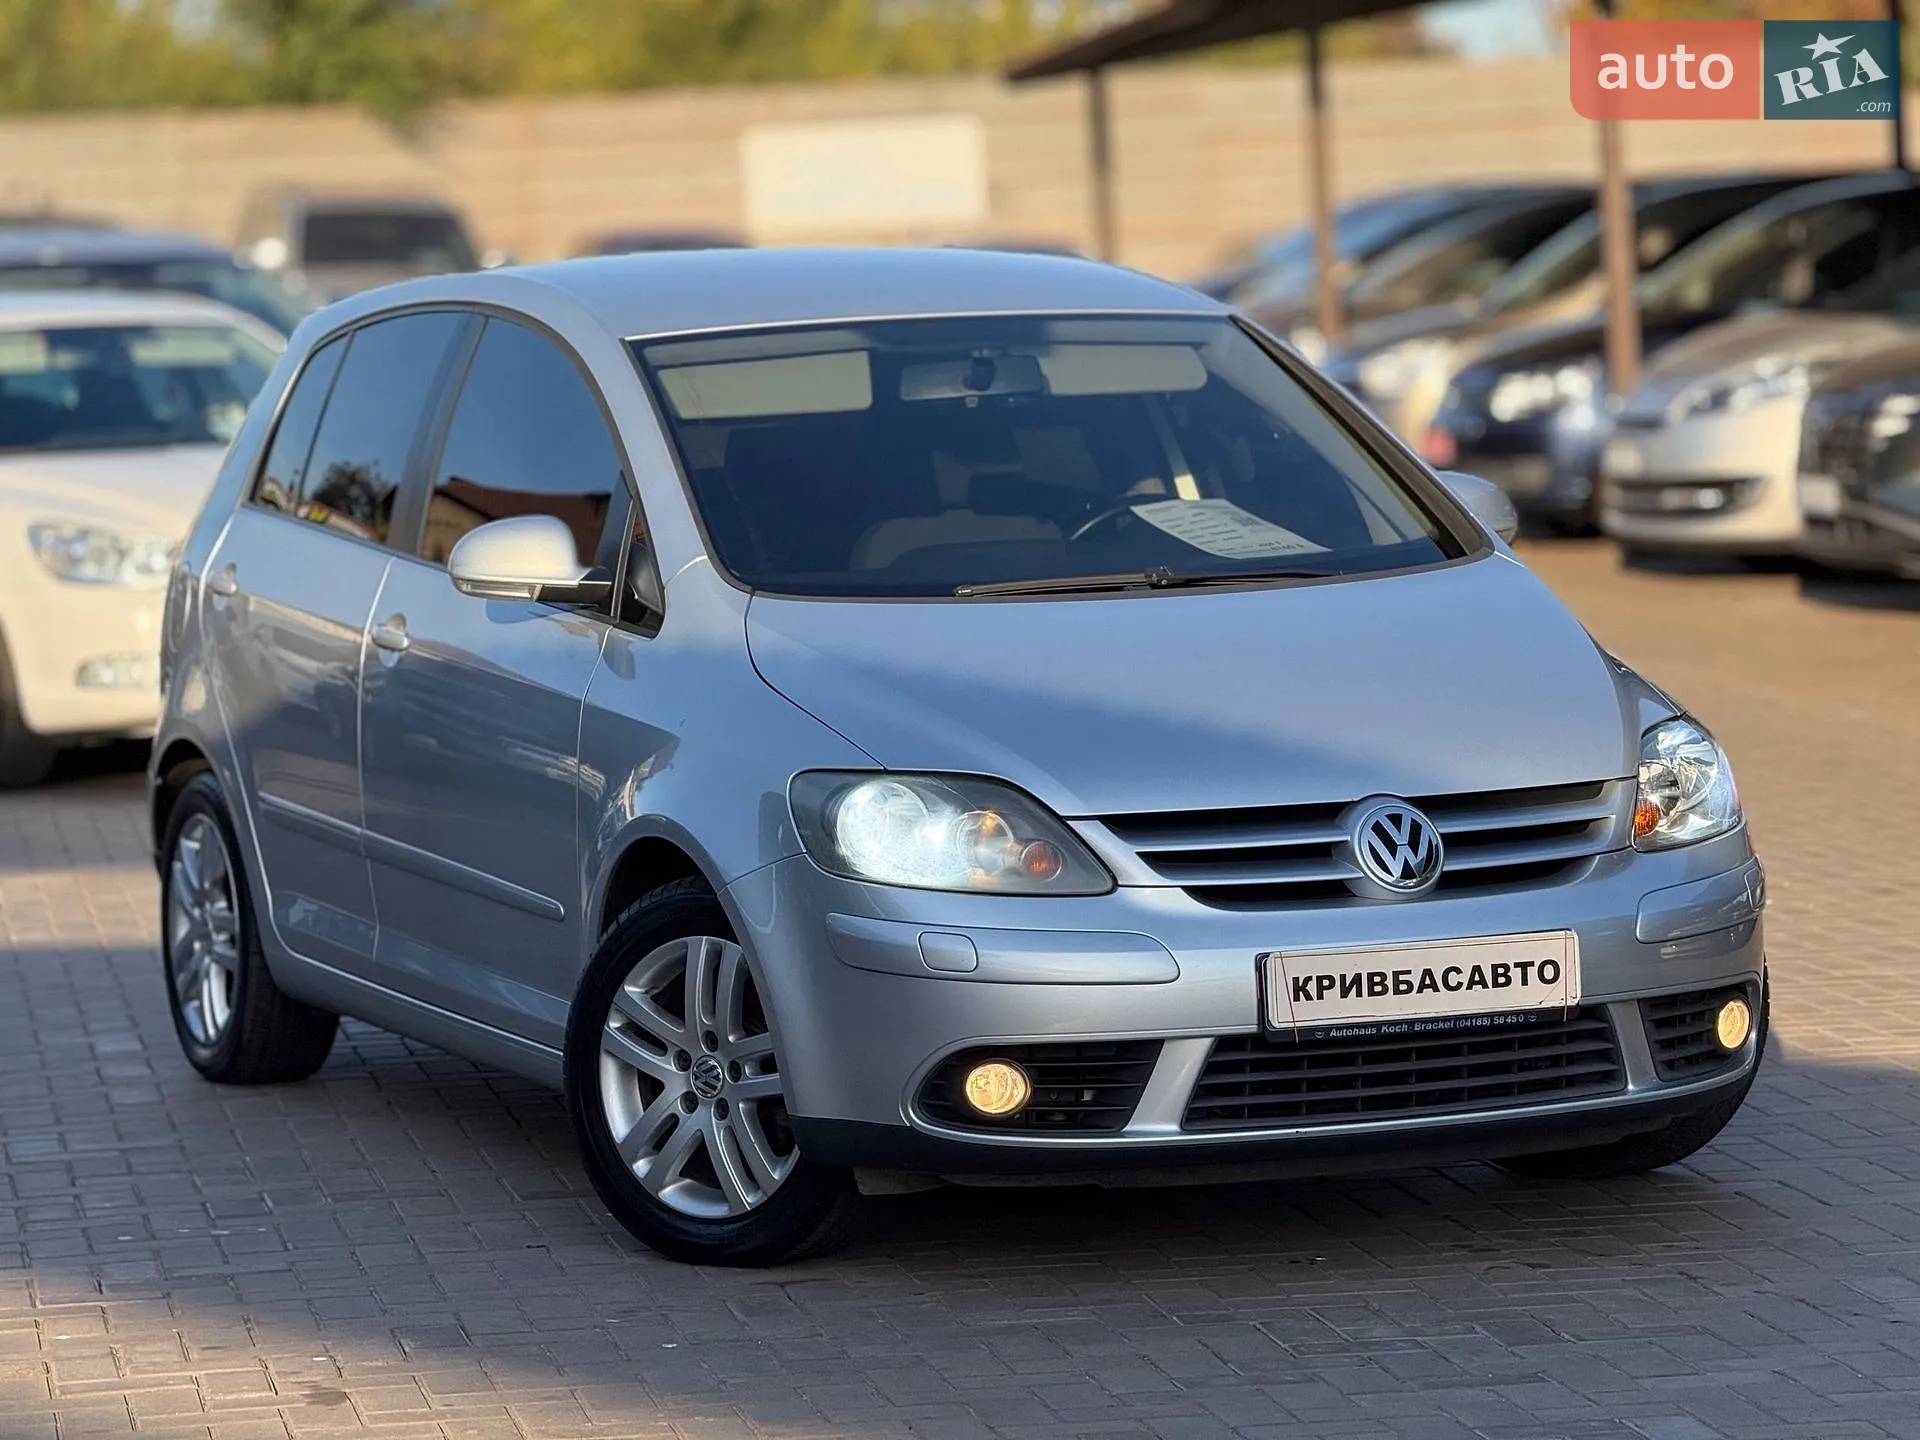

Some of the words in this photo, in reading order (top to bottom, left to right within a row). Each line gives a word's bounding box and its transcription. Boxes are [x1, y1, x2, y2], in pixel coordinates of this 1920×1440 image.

[1292, 959, 1561, 1003] КРИВБАСАВТО
[1329, 1027, 1377, 1037] Autohaus
[1414, 1020, 1454, 1031] Brackel
